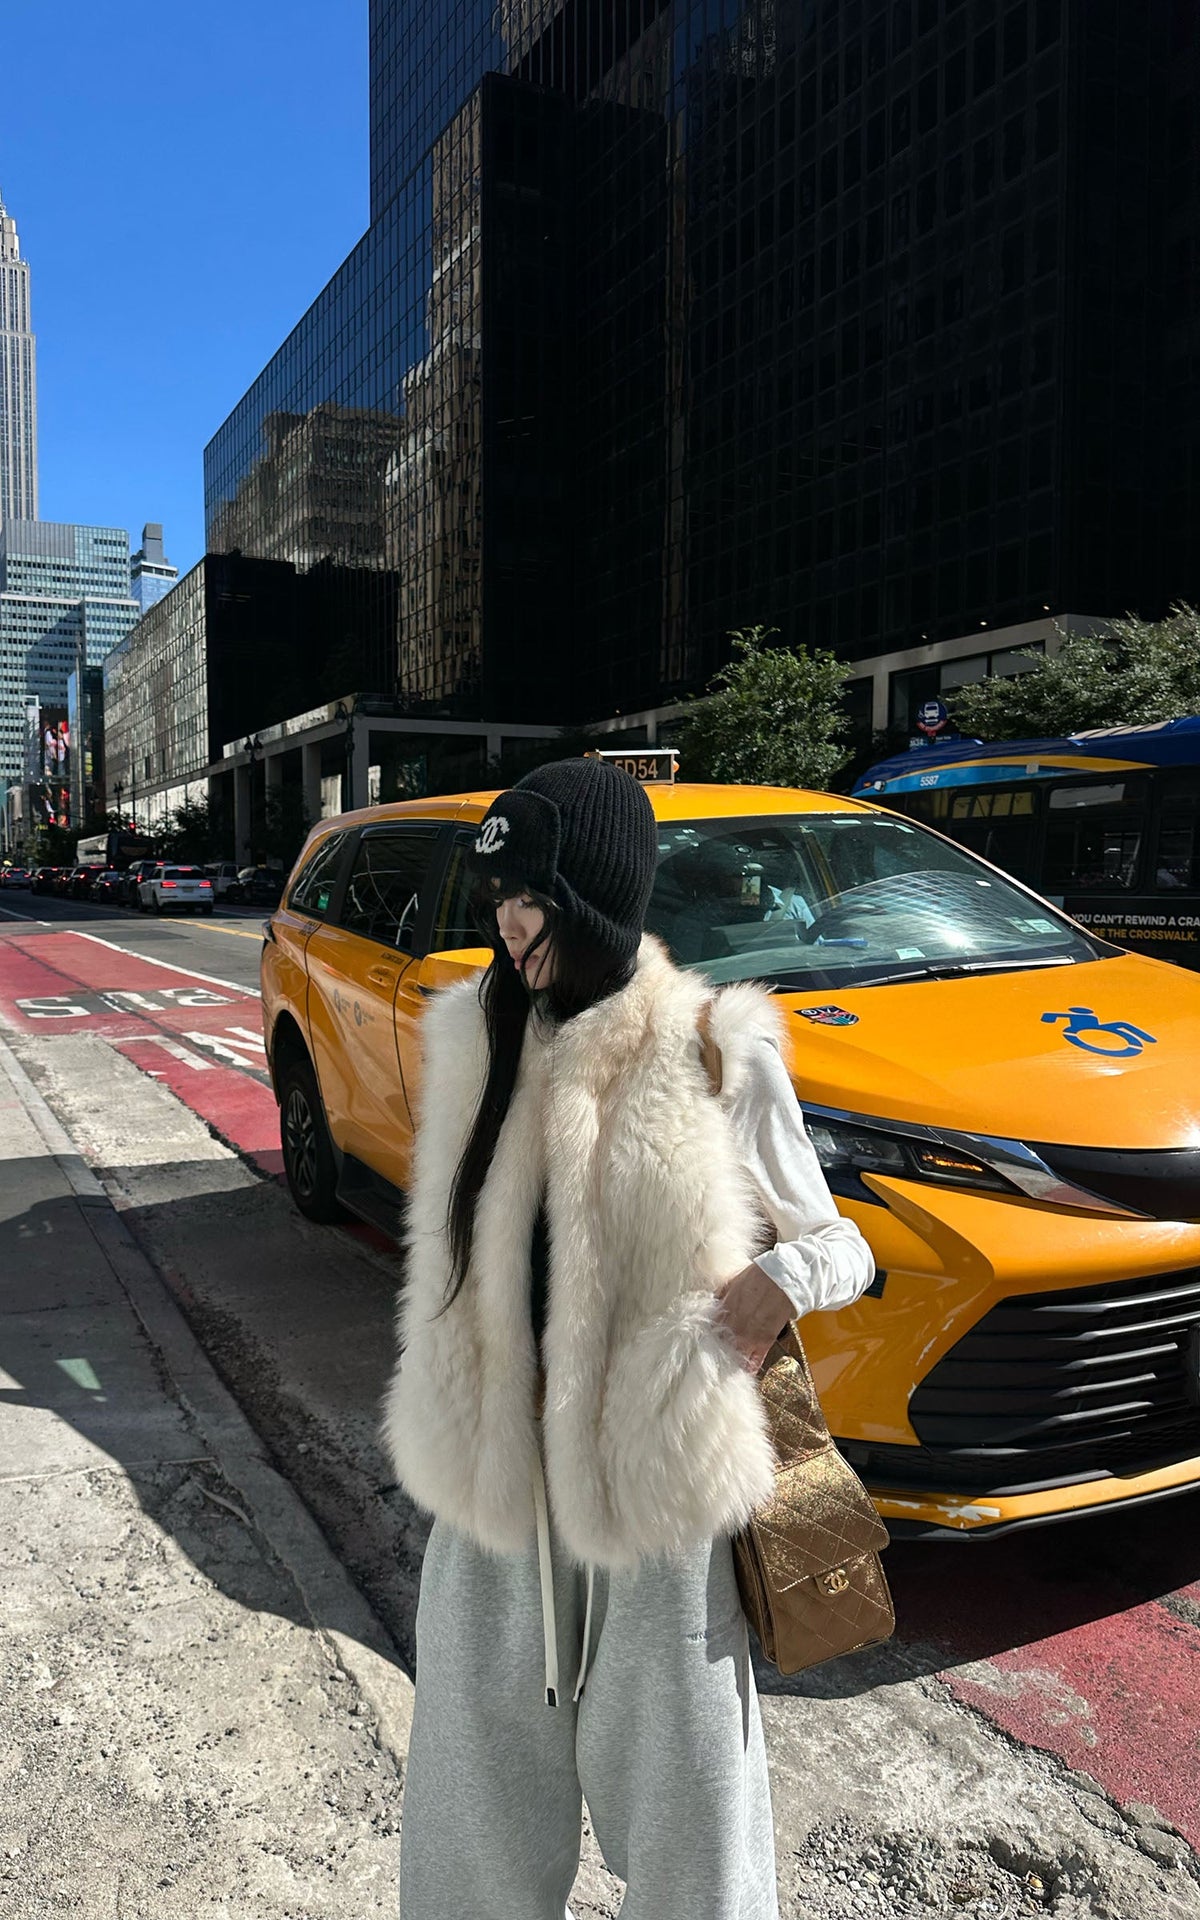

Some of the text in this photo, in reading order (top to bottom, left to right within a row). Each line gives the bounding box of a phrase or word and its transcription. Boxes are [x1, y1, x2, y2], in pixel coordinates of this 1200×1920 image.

[920, 774, 939, 787] 5587
[1071, 913, 1092, 923] YOU
[1093, 914, 1124, 925] CAN'T
[1125, 915, 1166, 926] REWIND
[1168, 916, 1177, 926] A
[1108, 928, 1127, 939] THE
[1128, 929, 1198, 942] CROSSWALK.
